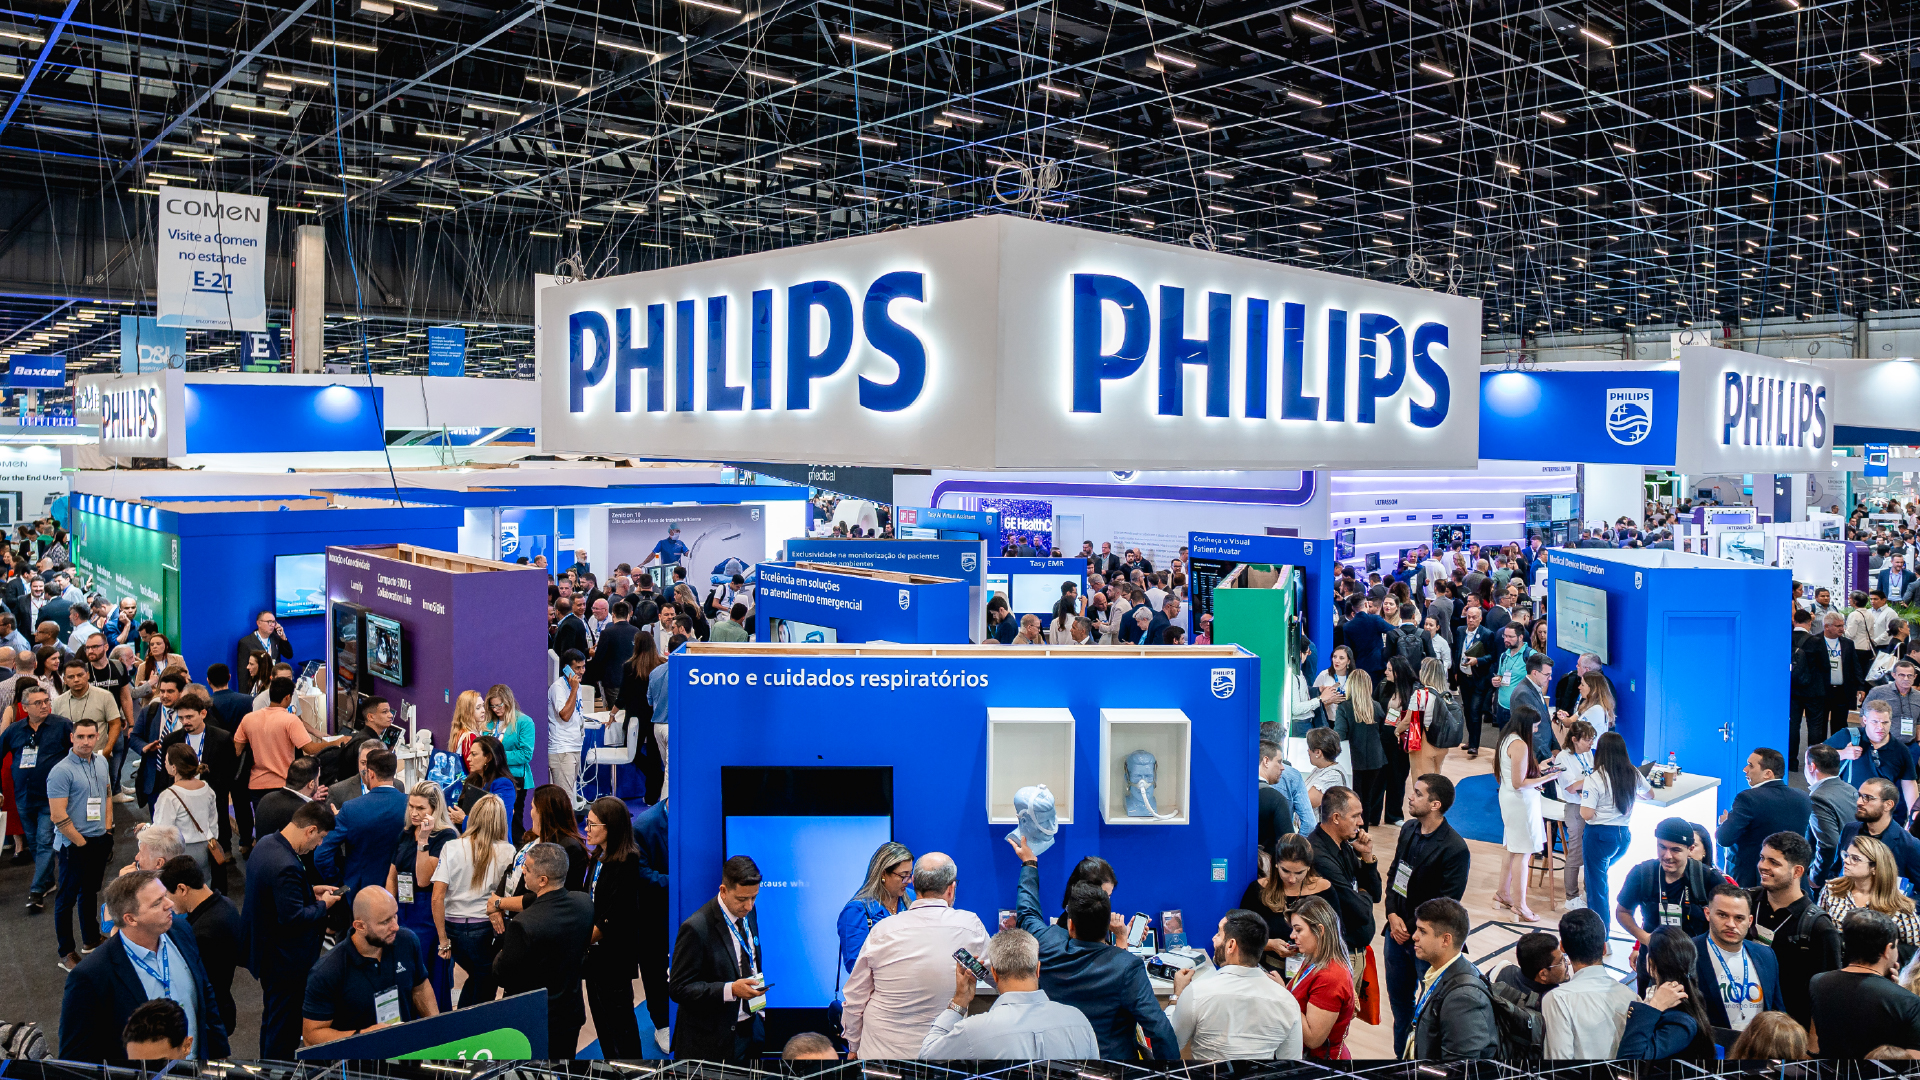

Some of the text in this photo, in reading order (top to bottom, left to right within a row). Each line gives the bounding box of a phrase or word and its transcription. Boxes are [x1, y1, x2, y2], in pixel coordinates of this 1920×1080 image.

[168, 228, 258, 247] Visite a Comen
[179, 251, 247, 265] no estande
[194, 270, 233, 290] E-21
[250, 333, 270, 358] E
[568, 271, 928, 413] PHILIPS
[1068, 272, 1451, 429] PHILIPS
[14, 366, 62, 377] Baxter
[1610, 392, 1650, 401] PHILIPS
[102, 387, 158, 439] PHILIPS
[1720, 371, 1827, 449] PHILIPS
[808, 469, 836, 482] medical
[1004, 517, 1016, 530] GE
[1193, 535, 1222, 545] Conheça
[1229, 538, 1250, 546] Visual
[1193, 545, 1242, 555] Patient Avatar
[848, 552, 896, 560] monitorização
[907, 553, 940, 561] pacientes
[1029, 560, 1046, 569] Tasy
[1549, 554, 1605, 575] Medical Device Integration
[350, 580, 364, 594] Lumify
[760, 570, 840, 592] Excelência em soluções
[376, 586, 412, 606] Collaboration Live
[760, 586, 863, 611] no atendimento emergencial
[422, 598, 445, 615] InnoSight
[688, 668, 989, 691] Sono e cuidados respiratórios
[757, 880, 787, 888] ecause
[1719, 982, 1764, 1004] 100
